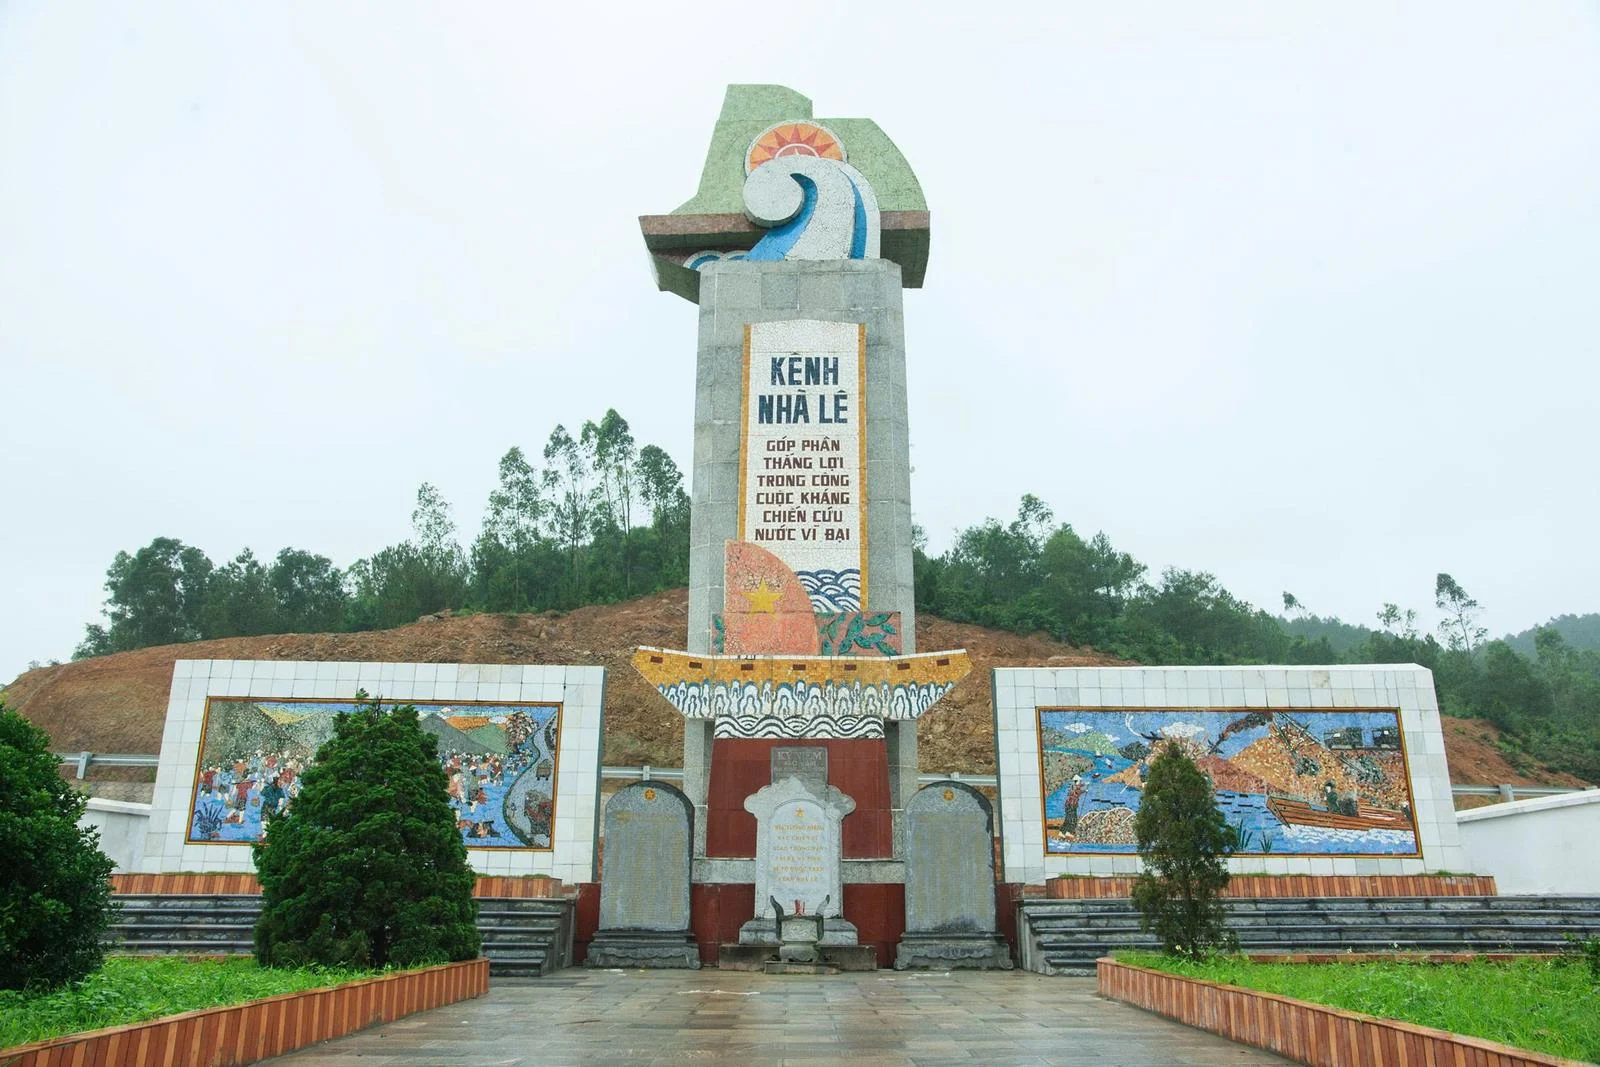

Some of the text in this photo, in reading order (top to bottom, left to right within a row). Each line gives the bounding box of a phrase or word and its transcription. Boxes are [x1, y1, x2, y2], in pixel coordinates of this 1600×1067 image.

[771, 352, 839, 385] KÊNH
[758, 389, 848, 424] NHÀ LÊ
[766, 435, 796, 451] GÓP
[763, 453, 844, 472] THẮNG LỢI
[757, 472, 850, 487] TRONG CÔNG
[756, 488, 850, 507] CUỘC KHÁNG
[763, 505, 843, 522] CHIẾN CỨU
[755, 524, 796, 541] NƯỚC
[824, 528, 850, 543] ĐẠI
